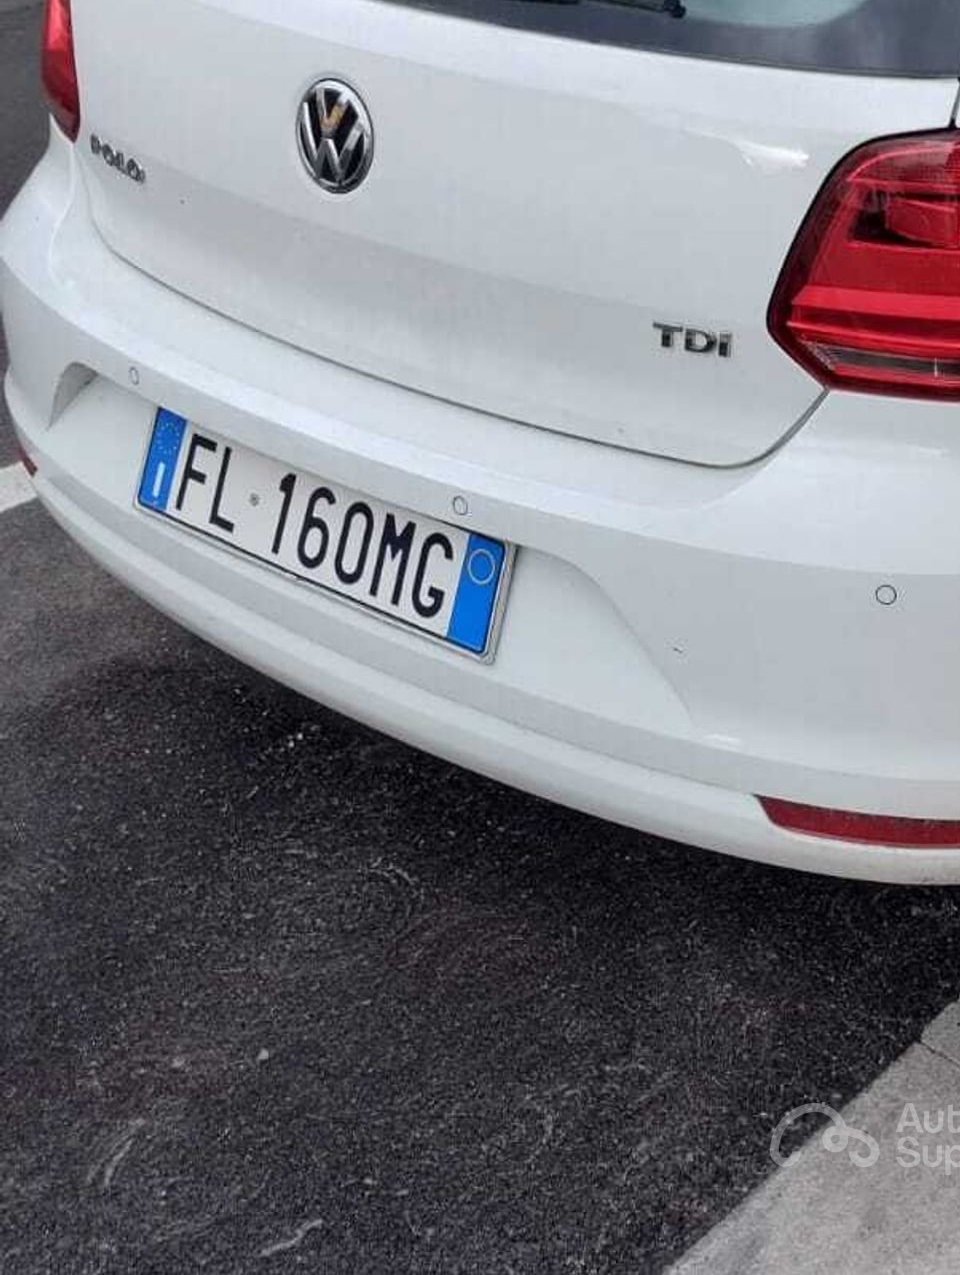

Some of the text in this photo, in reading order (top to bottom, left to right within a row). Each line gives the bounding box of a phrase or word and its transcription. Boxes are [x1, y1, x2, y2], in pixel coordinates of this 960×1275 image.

[90, 133, 146, 184] POLO
[653, 322, 732, 357] TDI
[176, 433, 455, 619] FL 160MG
